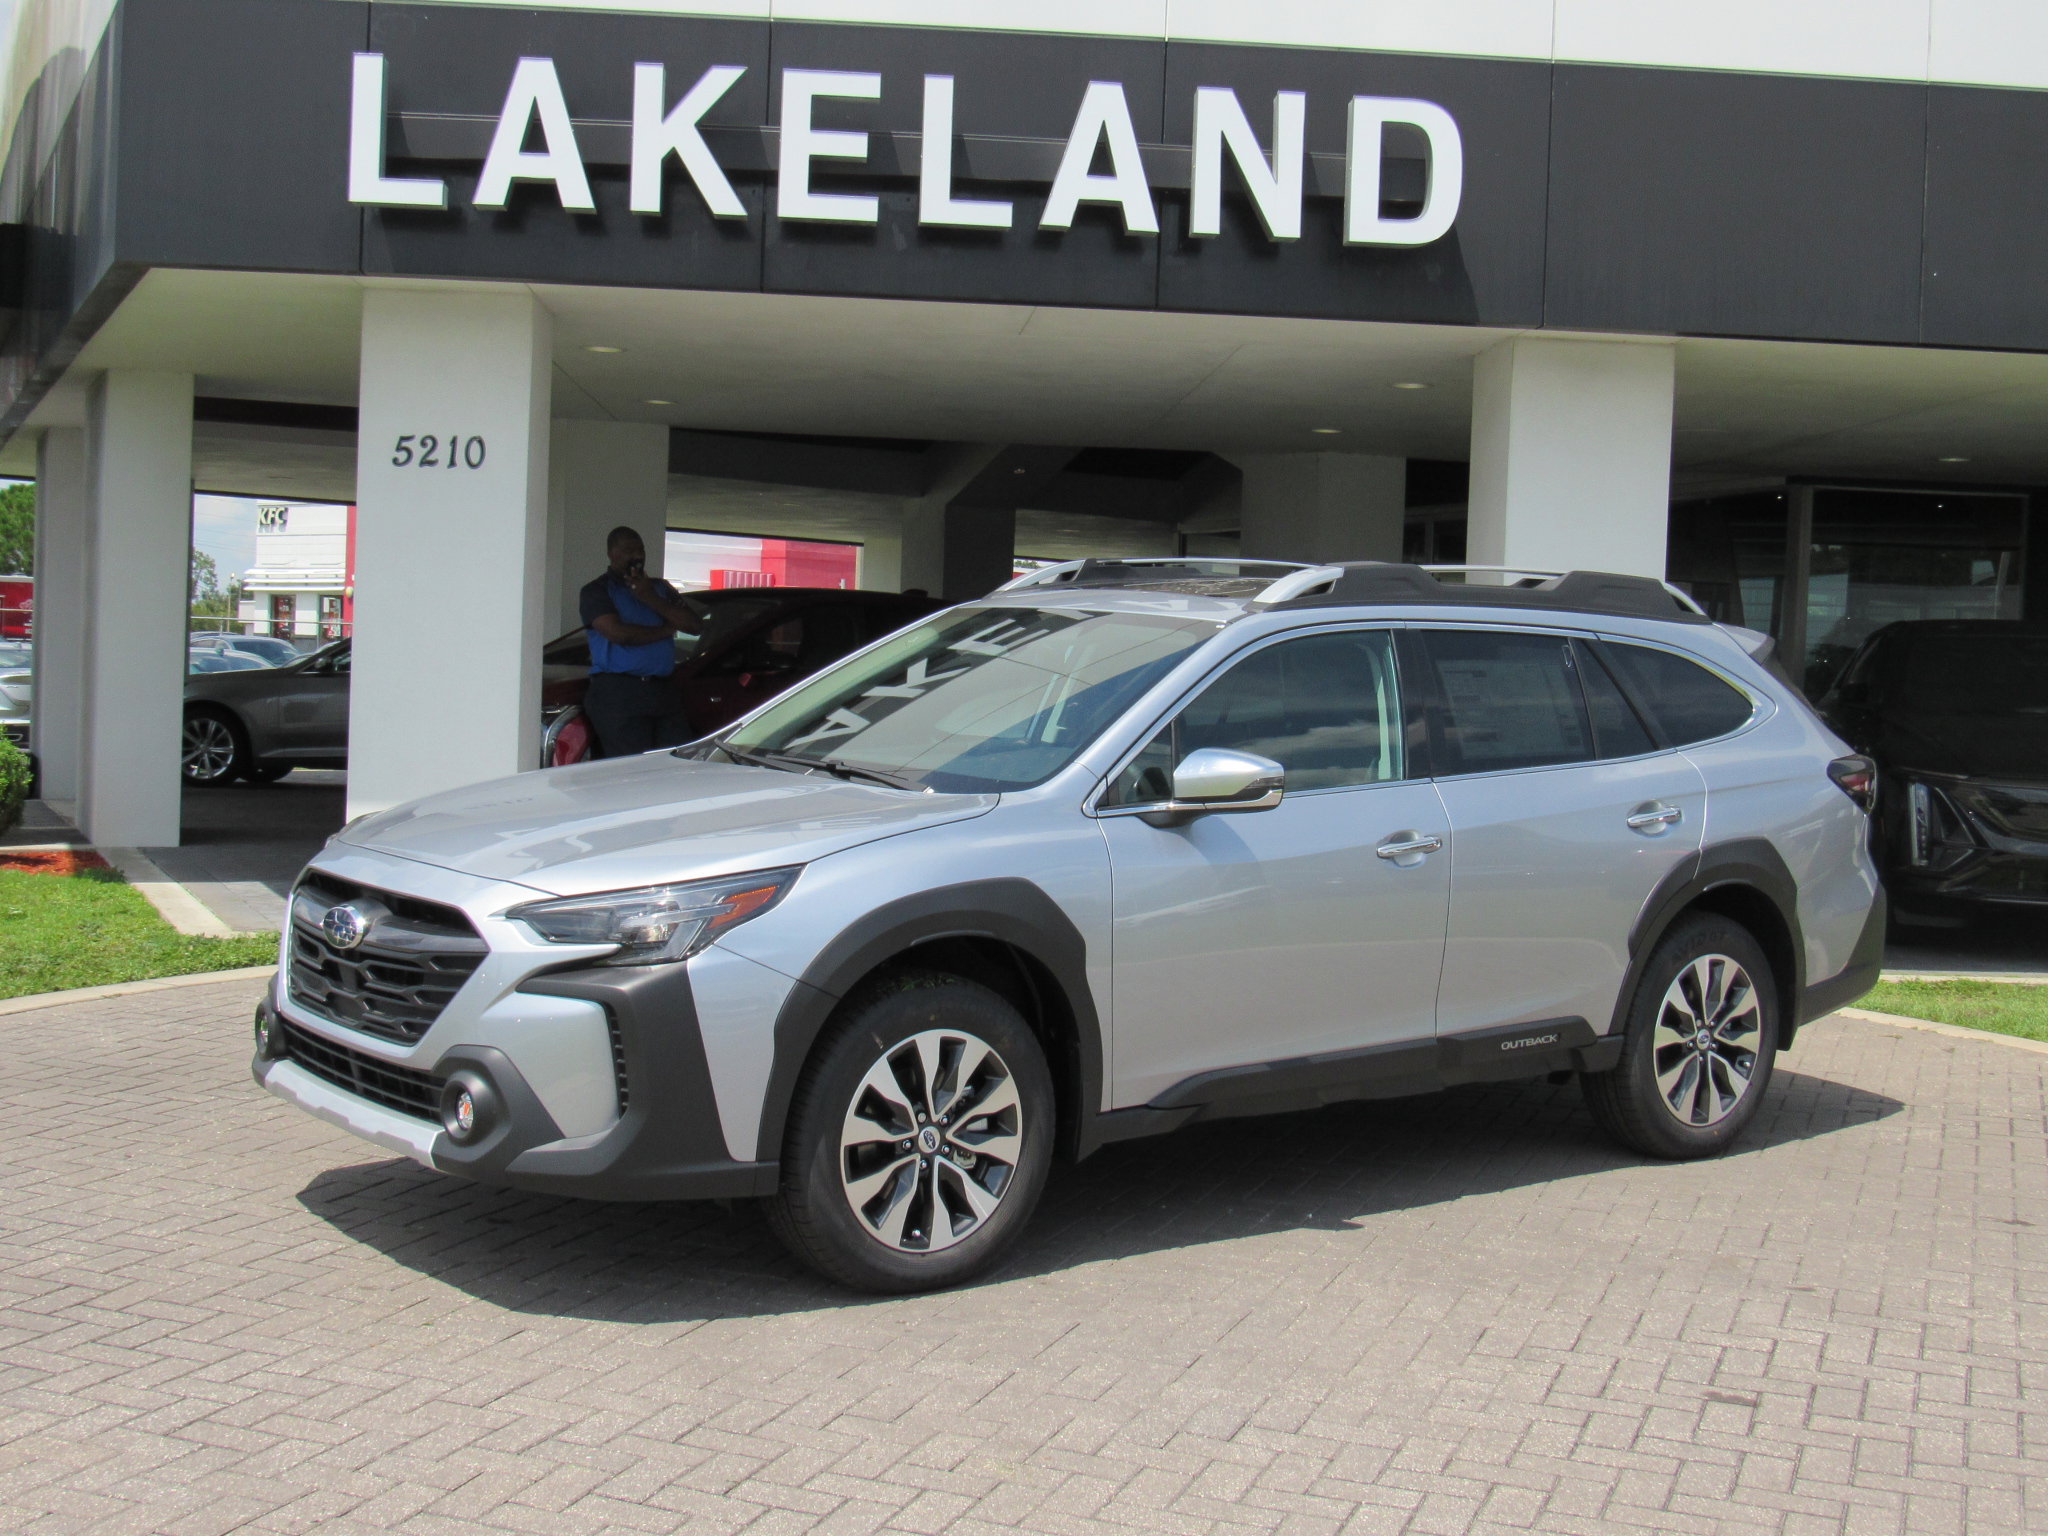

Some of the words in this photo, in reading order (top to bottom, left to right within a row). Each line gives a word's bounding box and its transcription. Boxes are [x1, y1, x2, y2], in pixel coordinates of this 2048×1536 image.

[349, 52, 1463, 248] LAKELAND
[392, 434, 486, 469] 5210
[257, 507, 288, 527] KFC
[1501, 1033, 1559, 1050] OUTBACK
